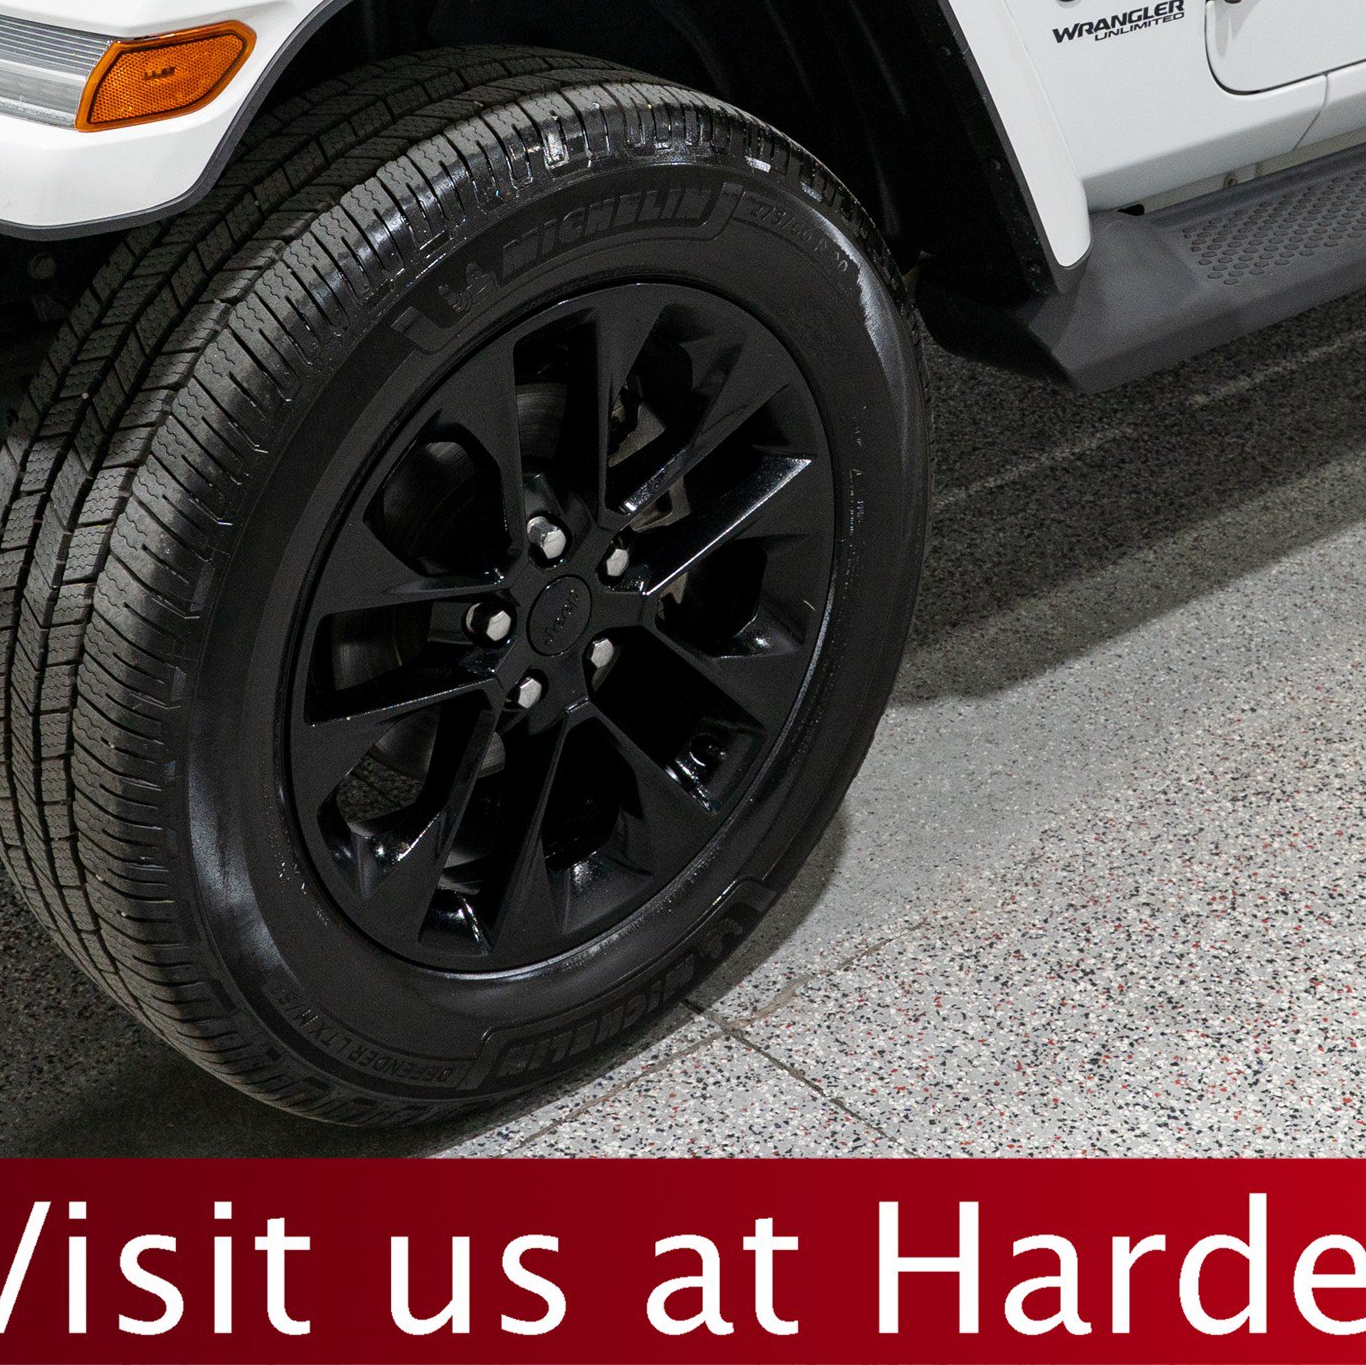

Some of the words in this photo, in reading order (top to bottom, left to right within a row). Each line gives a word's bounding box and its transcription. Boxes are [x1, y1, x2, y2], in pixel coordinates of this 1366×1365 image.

[1094, 12, 1185, 42] UNLIMITED
[501, 187, 712, 279] MICHELIN
[346, 1044, 454, 1083] DEFENDER
